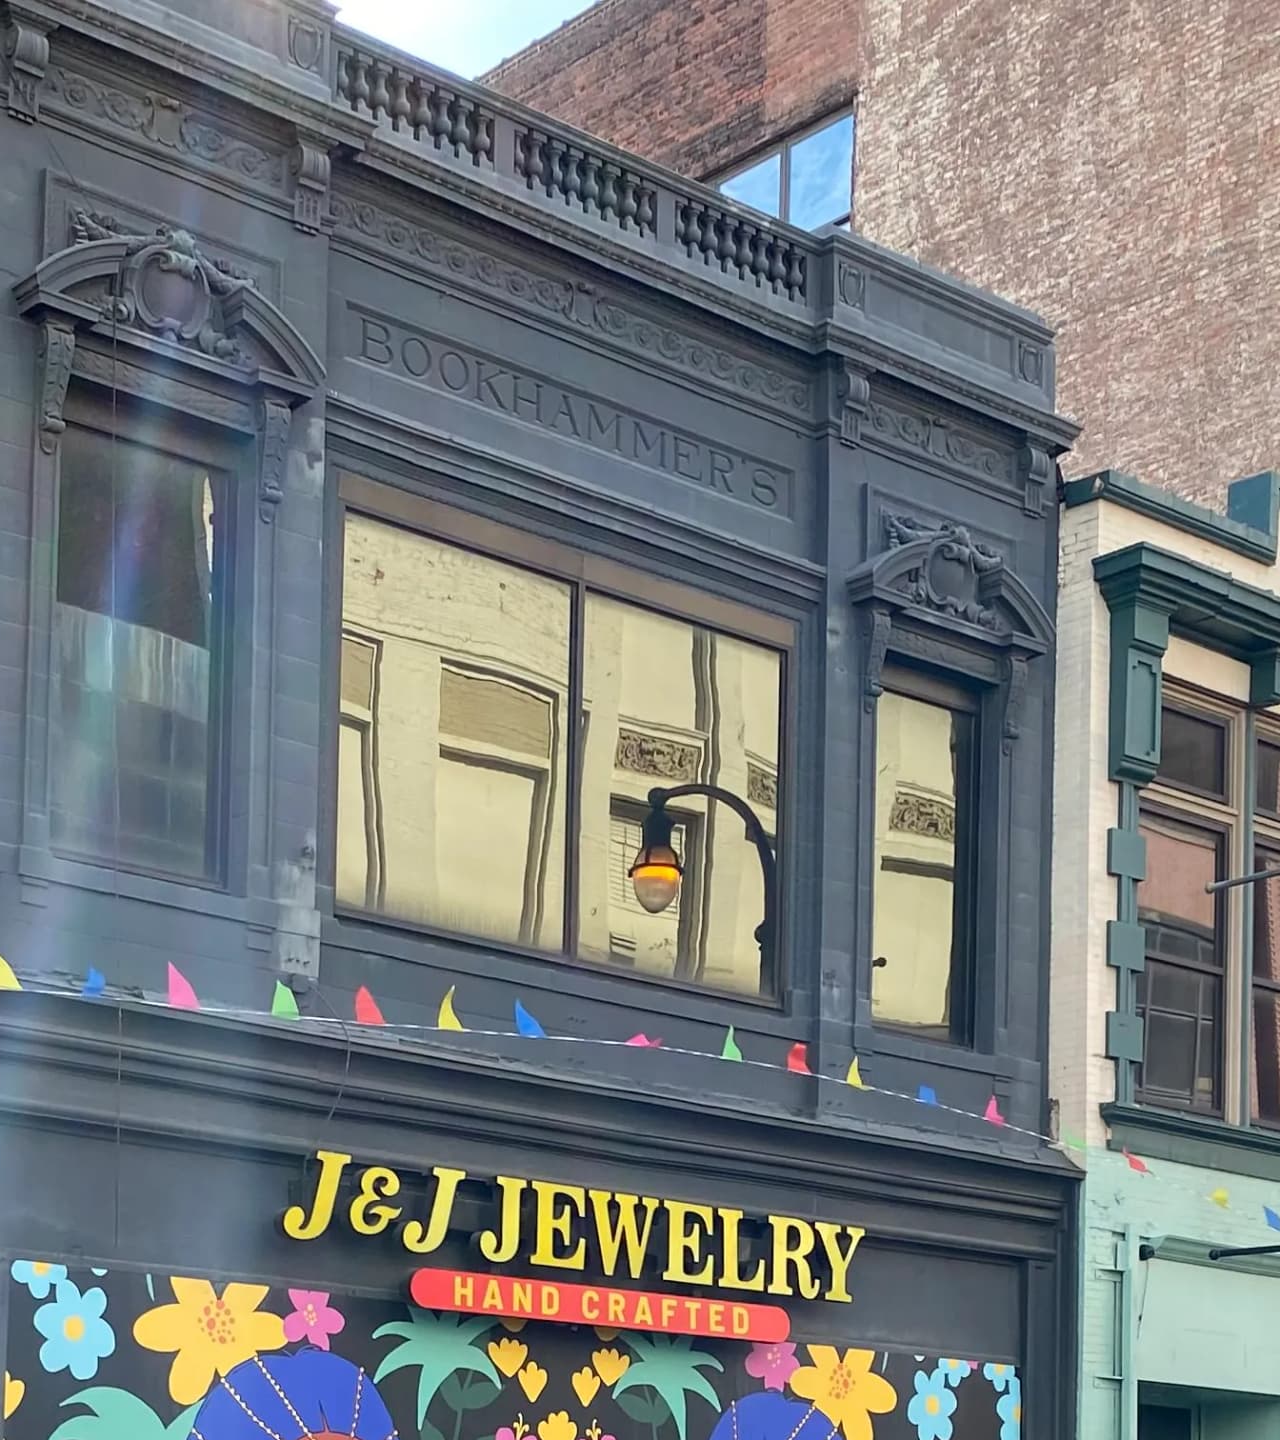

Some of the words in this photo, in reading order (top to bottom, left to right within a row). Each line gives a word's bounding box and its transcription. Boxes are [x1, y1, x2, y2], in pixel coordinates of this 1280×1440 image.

[358, 316, 780, 508] BOOKHAMMER'S
[281, 1149, 467, 1256] J&J
[477, 1174, 867, 1304] JEWELRY
[453, 1275, 561, 1316] HAND
[581, 1290, 751, 1336] CRAFTED
